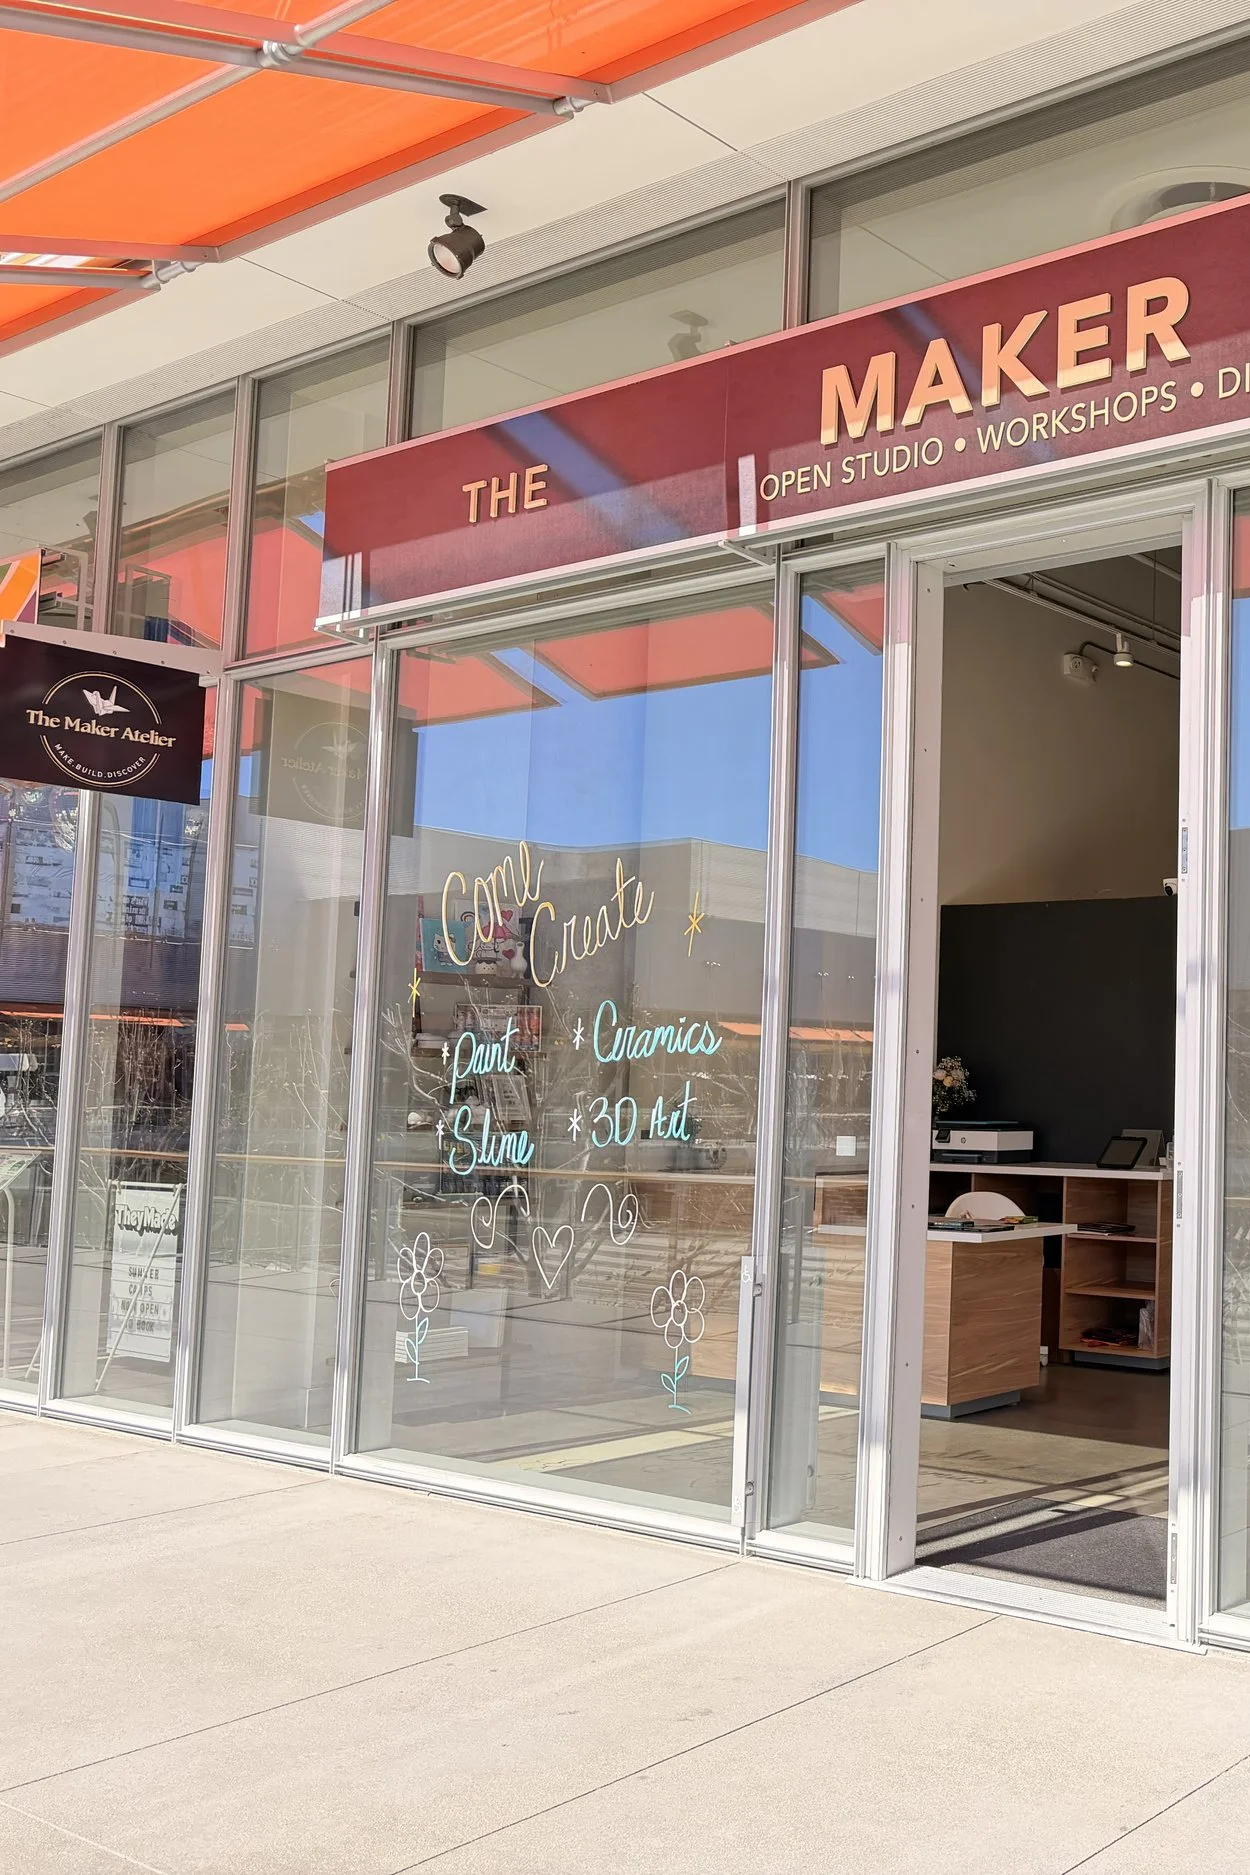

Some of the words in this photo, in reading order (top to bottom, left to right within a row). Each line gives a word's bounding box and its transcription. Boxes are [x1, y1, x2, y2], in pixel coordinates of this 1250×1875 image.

[462, 463, 549, 524] THE
[820, 277, 1191, 446] MAKER
[759, 461, 832, 502] OPEN
[841, 437, 943, 485] STUDIO
[976, 380, 1178, 454] WORKSHOPS
[26, 709, 61, 729] The
[64, 716, 119, 739] Maker
[121, 727, 177, 748] Atelier
[441, 840, 544, 967] Come
[529, 857, 655, 988] Create
[593, 999, 723, 1063] Ceramics
[449, 1105, 535, 1176] Slime
[588, 1096, 638, 1147] 3D
[648, 1080, 698, 1142] Art
